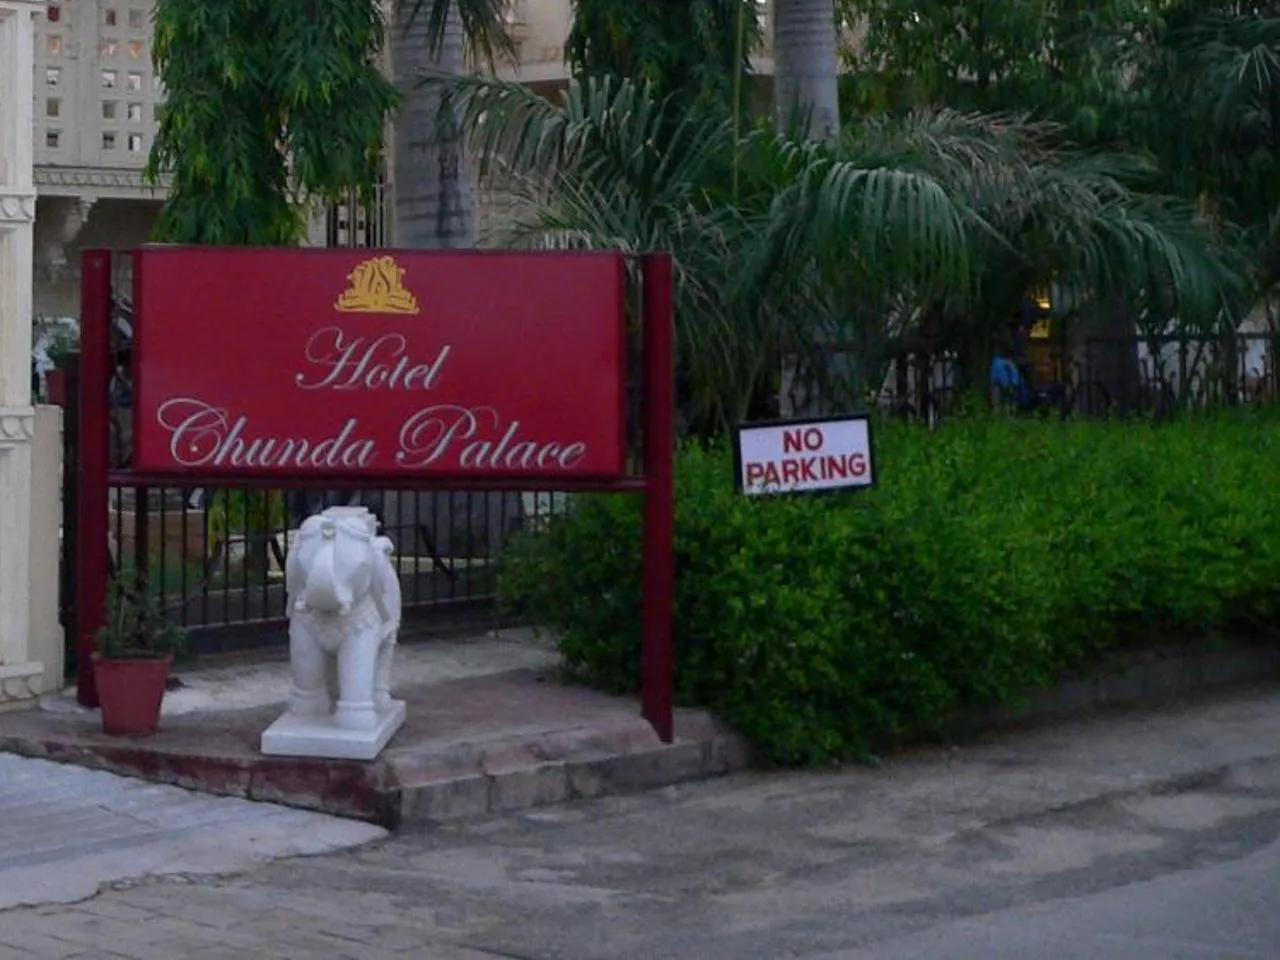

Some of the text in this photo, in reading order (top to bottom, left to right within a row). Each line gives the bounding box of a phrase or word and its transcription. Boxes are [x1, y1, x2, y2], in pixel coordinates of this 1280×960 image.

[296, 327, 450, 390] Hotel
[157, 397, 586, 470] Chunda Palace
[783, 428, 824, 453] NO
[746, 453, 867, 487] PARKING
